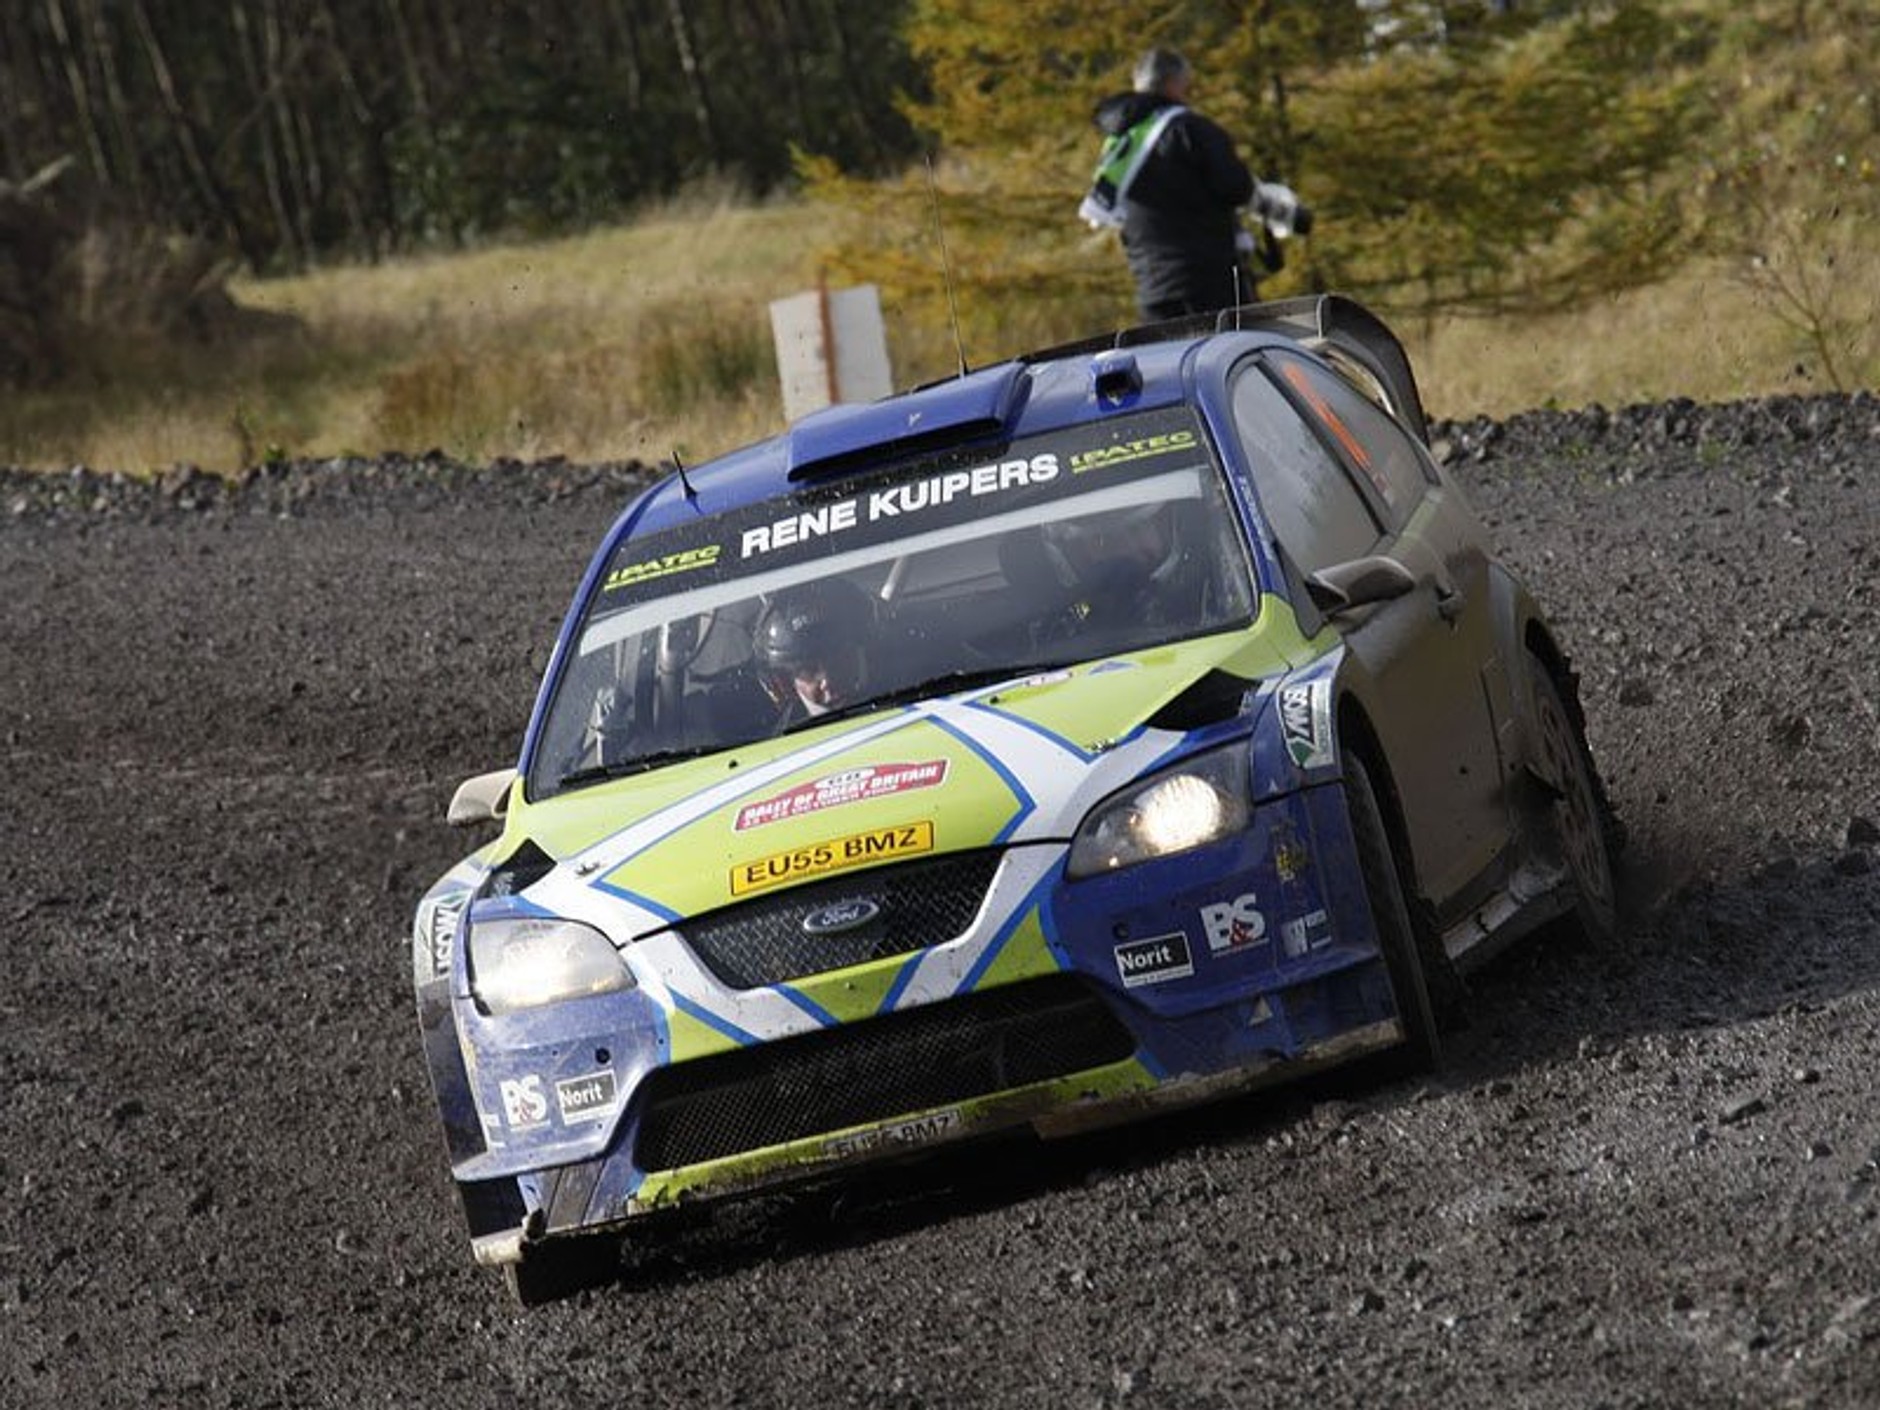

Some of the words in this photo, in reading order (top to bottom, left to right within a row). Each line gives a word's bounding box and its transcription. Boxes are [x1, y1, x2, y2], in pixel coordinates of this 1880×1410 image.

[741, 499, 857, 558] RENE
[870, 453, 1059, 521] KUIPERS
[744, 797, 792, 820] RALLY
[794, 791, 815, 809] OF
[817, 780, 868, 803] GREAT
[871, 765, 939, 791] BRITAIN
[747, 846, 833, 883] EU55
[844, 828, 918, 859] BMZ
[821, 904, 859, 925] Ford
[1200, 893, 1266, 951] B&S
[1119, 945, 1173, 970] Norit
[559, 1082, 604, 1108] Norit
